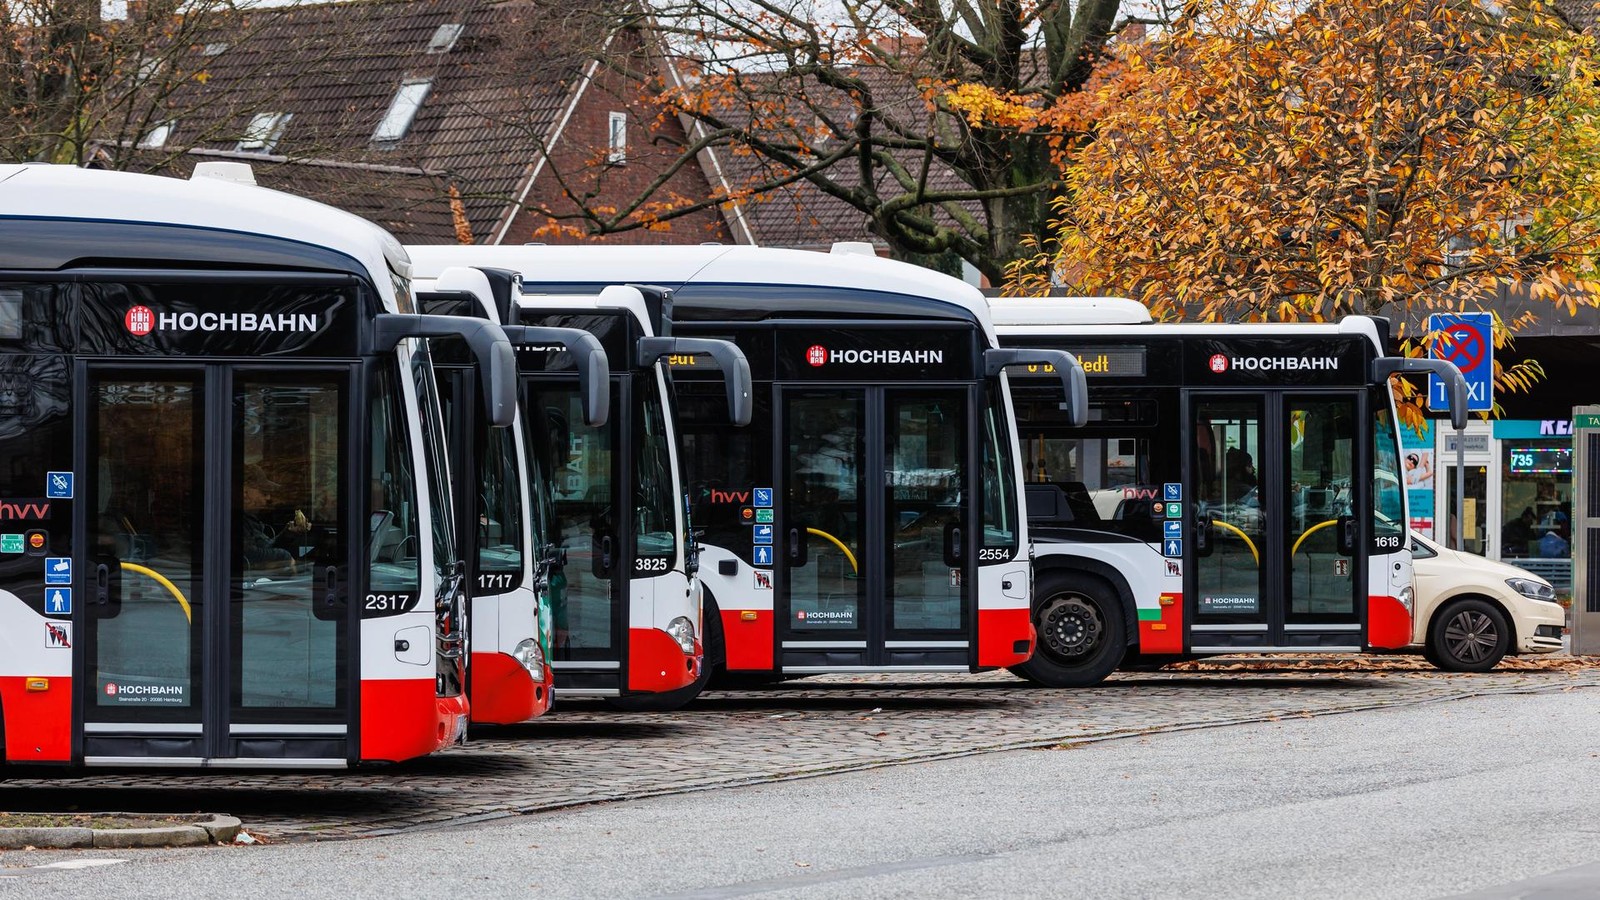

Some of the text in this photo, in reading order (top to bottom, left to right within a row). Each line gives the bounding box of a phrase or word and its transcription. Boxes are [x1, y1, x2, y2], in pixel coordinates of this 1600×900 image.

[159, 312, 317, 332] HOCHBAHN
[830, 350, 943, 363] HOCHBAHN
[1231, 357, 1338, 370] HOCHBAHN
[1436, 382, 1485, 402] TXI
[711, 489, 749, 503] hvv
[1122, 486, 1158, 499] hvv
[0, 501, 49, 519] hvv
[1374, 536, 1399, 547] 1618
[979, 549, 1010, 560] 2554
[635, 558, 667, 571] 3825
[478, 574, 513, 588] 1717
[365, 594, 409, 610] 2317
[118, 685, 183, 694] HOCHBAHN
